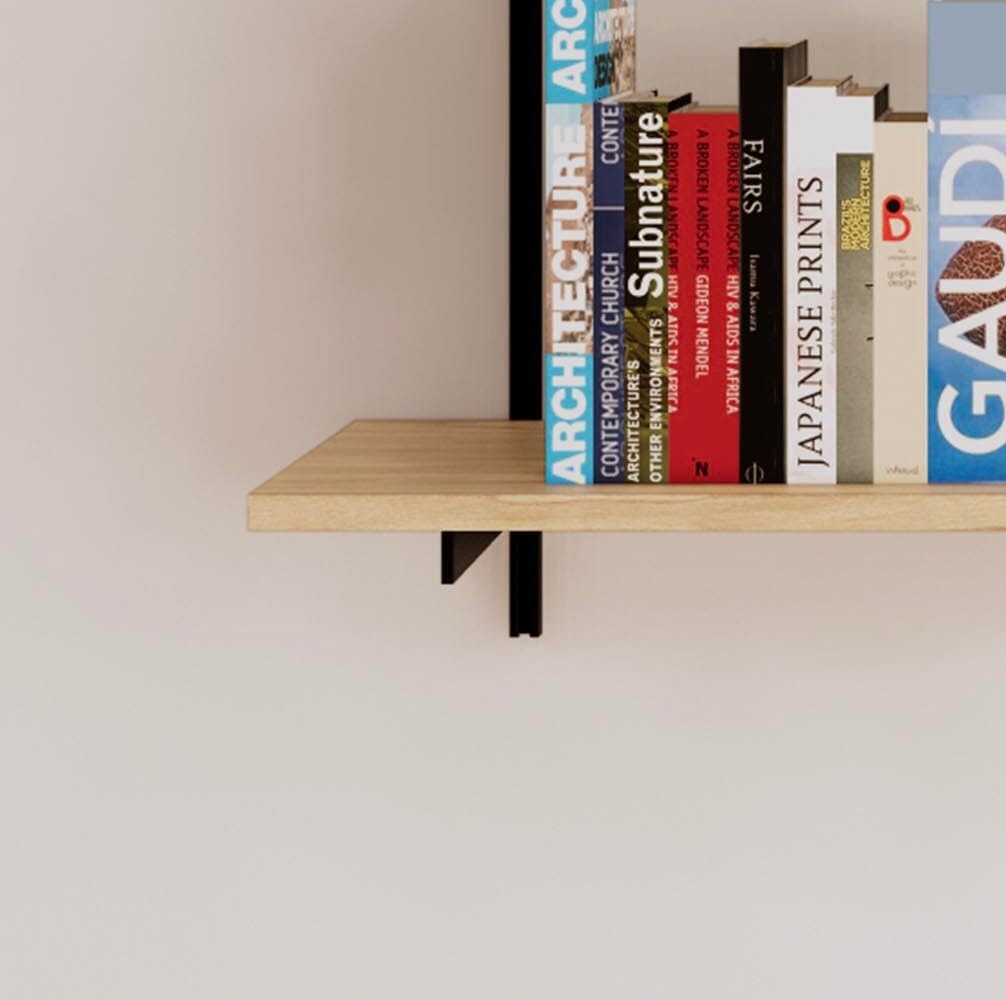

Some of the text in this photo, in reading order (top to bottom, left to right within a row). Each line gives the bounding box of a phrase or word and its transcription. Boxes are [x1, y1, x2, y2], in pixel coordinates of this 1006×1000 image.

[601, 99, 620, 165] CONTE
[668, 142, 679, 192] BROKEN
[627, 112, 664, 298] Subnature
[742, 139, 764, 214] FAIRS
[860, 160, 870, 251] ARCHITECTURE
[668, 197, 679, 271] LANDSCAPE
[695, 129, 710, 379] A BROKEN LANDSCAPE GIDEON MENDEL
[850, 198, 860, 251] MODERN
[551, 125, 587, 485] ARCHITECTURE
[668, 274, 679, 298] HIV
[726, 129, 739, 414] A BROKEN LANDSCAPE HIV & AIDS IN AFRICA
[668, 314, 679, 346] AIDS
[668, 349, 679, 365] IN
[797, 176, 829, 467] JAPANESE PRINTS
[601, 252, 620, 478] CONTEMPORARY CHURCH
[649, 317, 663, 483] OTHER ENVIRONMENTS
[668, 367, 679, 414] AFRICA
[627, 359, 641, 483] ARCHITECTURE'S
